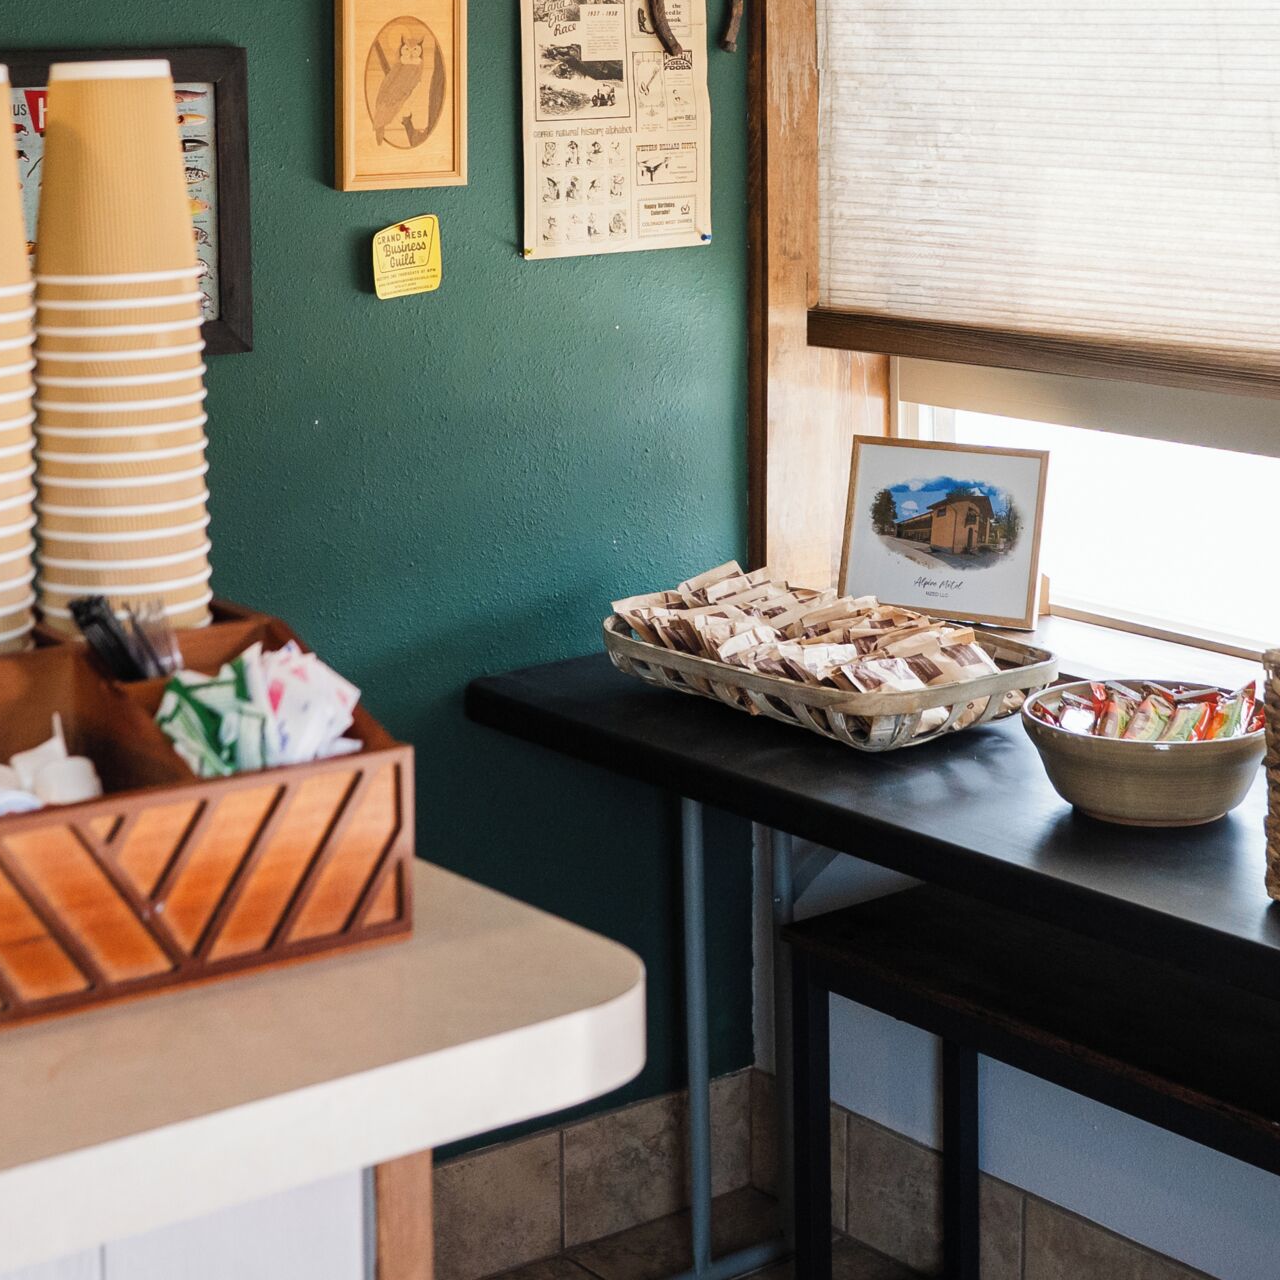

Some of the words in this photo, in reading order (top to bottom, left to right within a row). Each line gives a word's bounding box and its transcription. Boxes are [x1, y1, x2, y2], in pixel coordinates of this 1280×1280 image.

[553, 22, 577, 37] Race
[377, 233, 402, 245] GRAND
[404, 229, 429, 240] MESA
[383, 240, 427, 258] Business
[389, 252, 416, 269] Guild
[913, 576, 937, 589] Alpine
